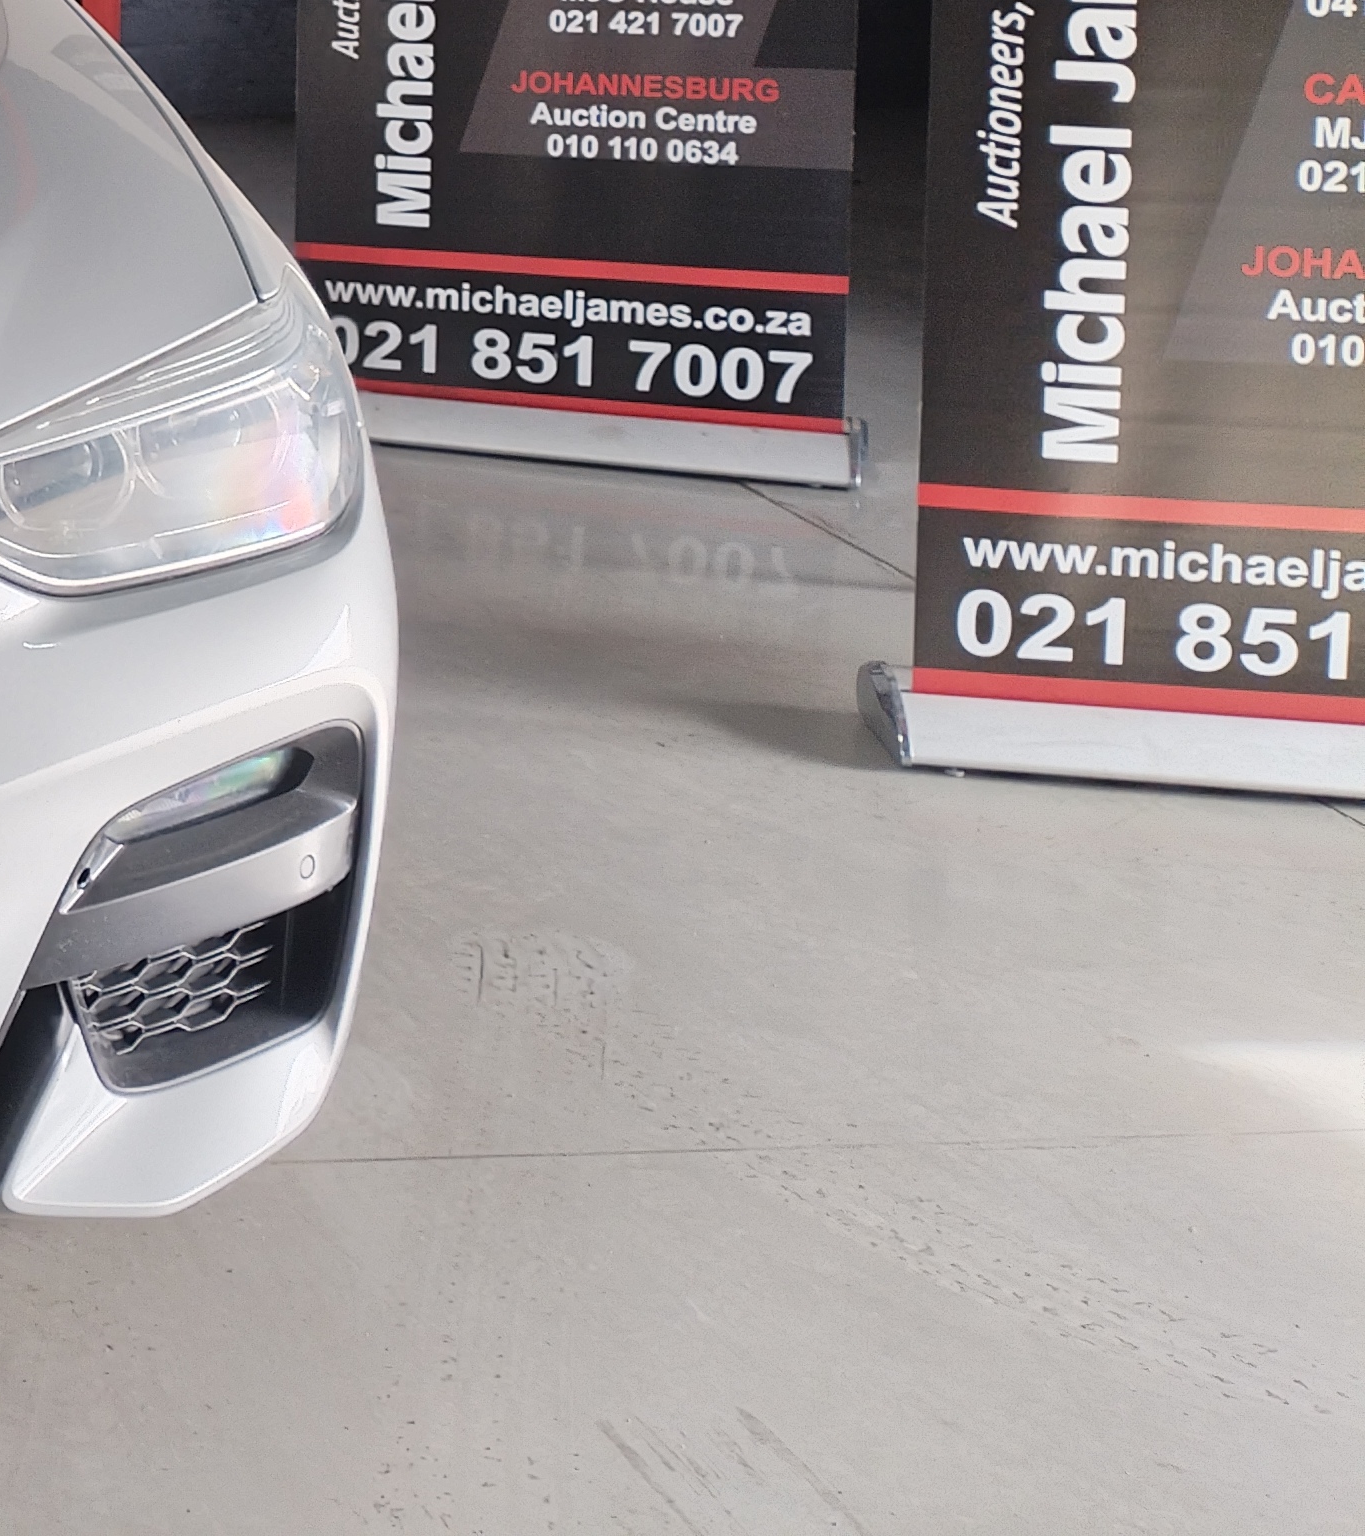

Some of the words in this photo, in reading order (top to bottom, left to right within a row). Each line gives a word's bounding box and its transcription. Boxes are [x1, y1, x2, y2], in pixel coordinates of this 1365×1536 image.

[548, 9, 599, 34] 021
[608, 10, 660, 36] 421
[671, 12, 744, 38] 7007
[510, 70, 780, 103] JOHANNESBURG
[529, 101, 647, 130] Auction
[655, 106, 758, 135] Centre
[976, 1, 1035, 229] Auctioneers,
[546, 133, 599, 159] 010
[607, 135, 659, 162] 110
[665, 138, 740, 166] 0634
[324, 279, 812, 337] www.michaeljames.co.za
[1040, 124, 1133, 470] Michael
[334, 317, 439, 373] 021
[471, 328, 594, 387] 851
[628, 339, 814, 404] 7007
[1290, 332, 1365, 366] 010
[956, 588, 1126, 666] 021
[1175, 602, 1351, 680] 851
